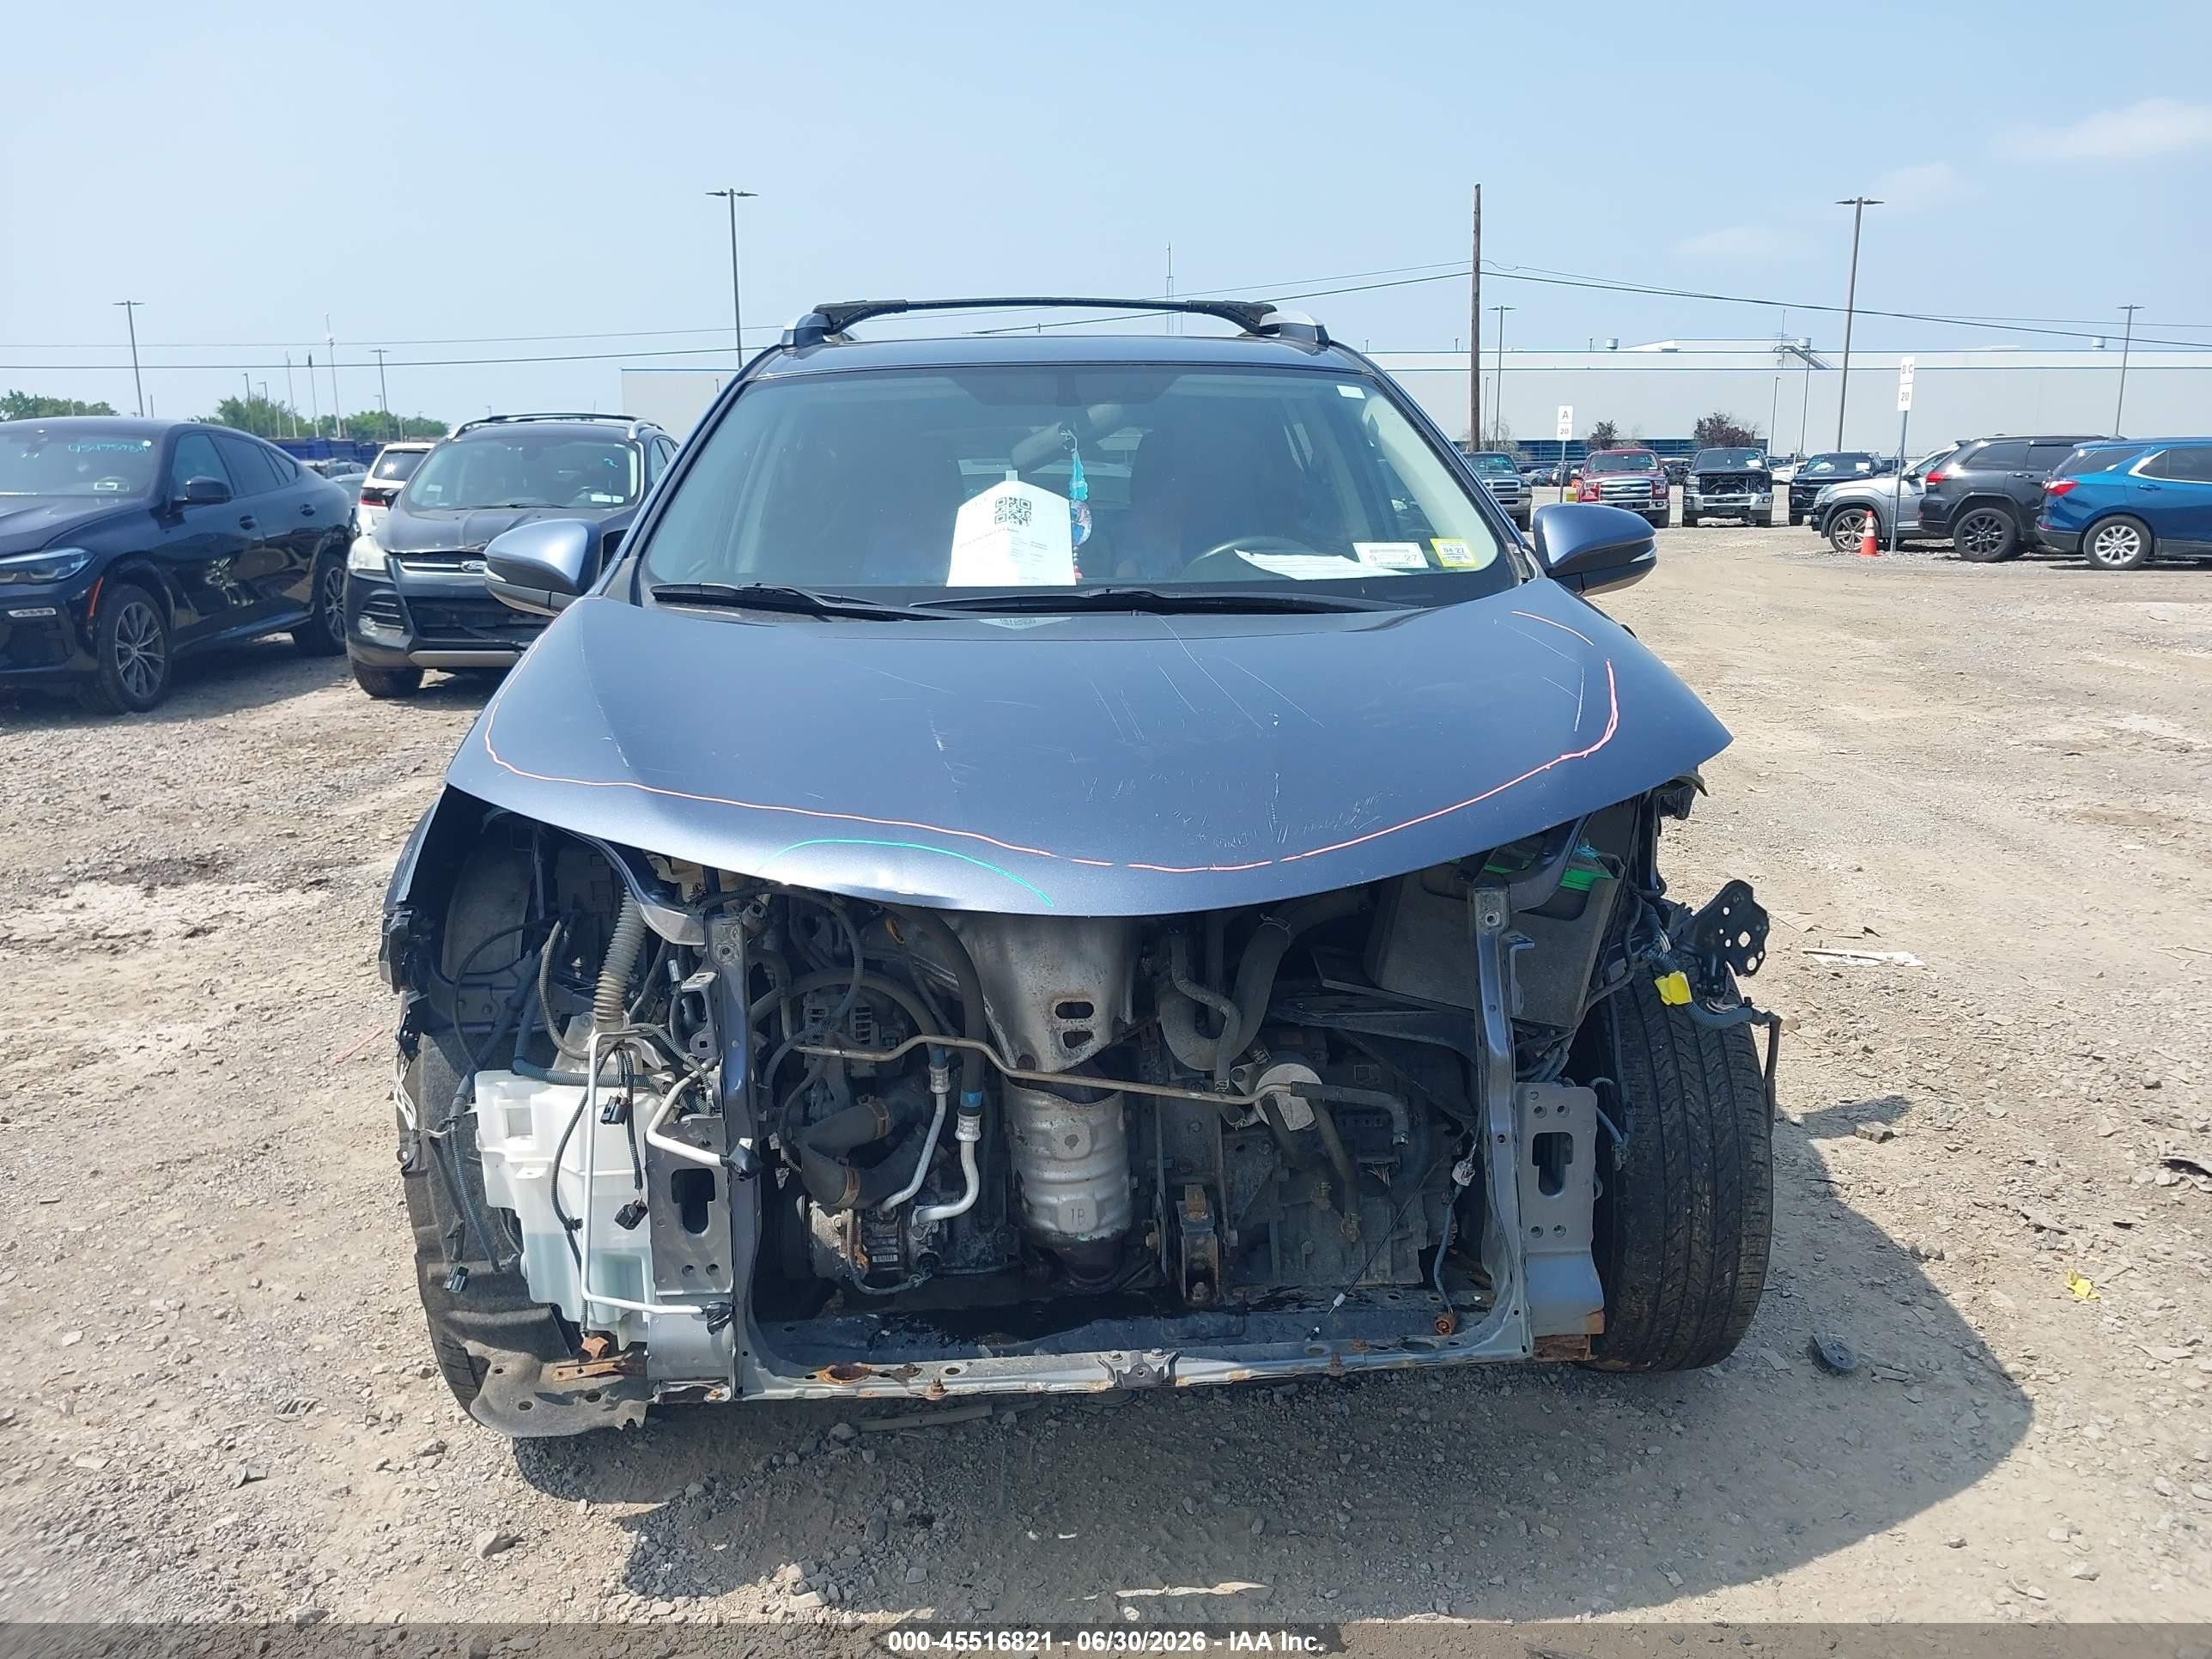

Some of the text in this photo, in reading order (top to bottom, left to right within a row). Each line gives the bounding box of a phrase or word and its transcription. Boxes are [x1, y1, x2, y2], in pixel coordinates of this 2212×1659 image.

[1908, 363, 1914, 374] C
[1900, 392, 1910, 402] 20
[1561, 410, 1569, 420] A
